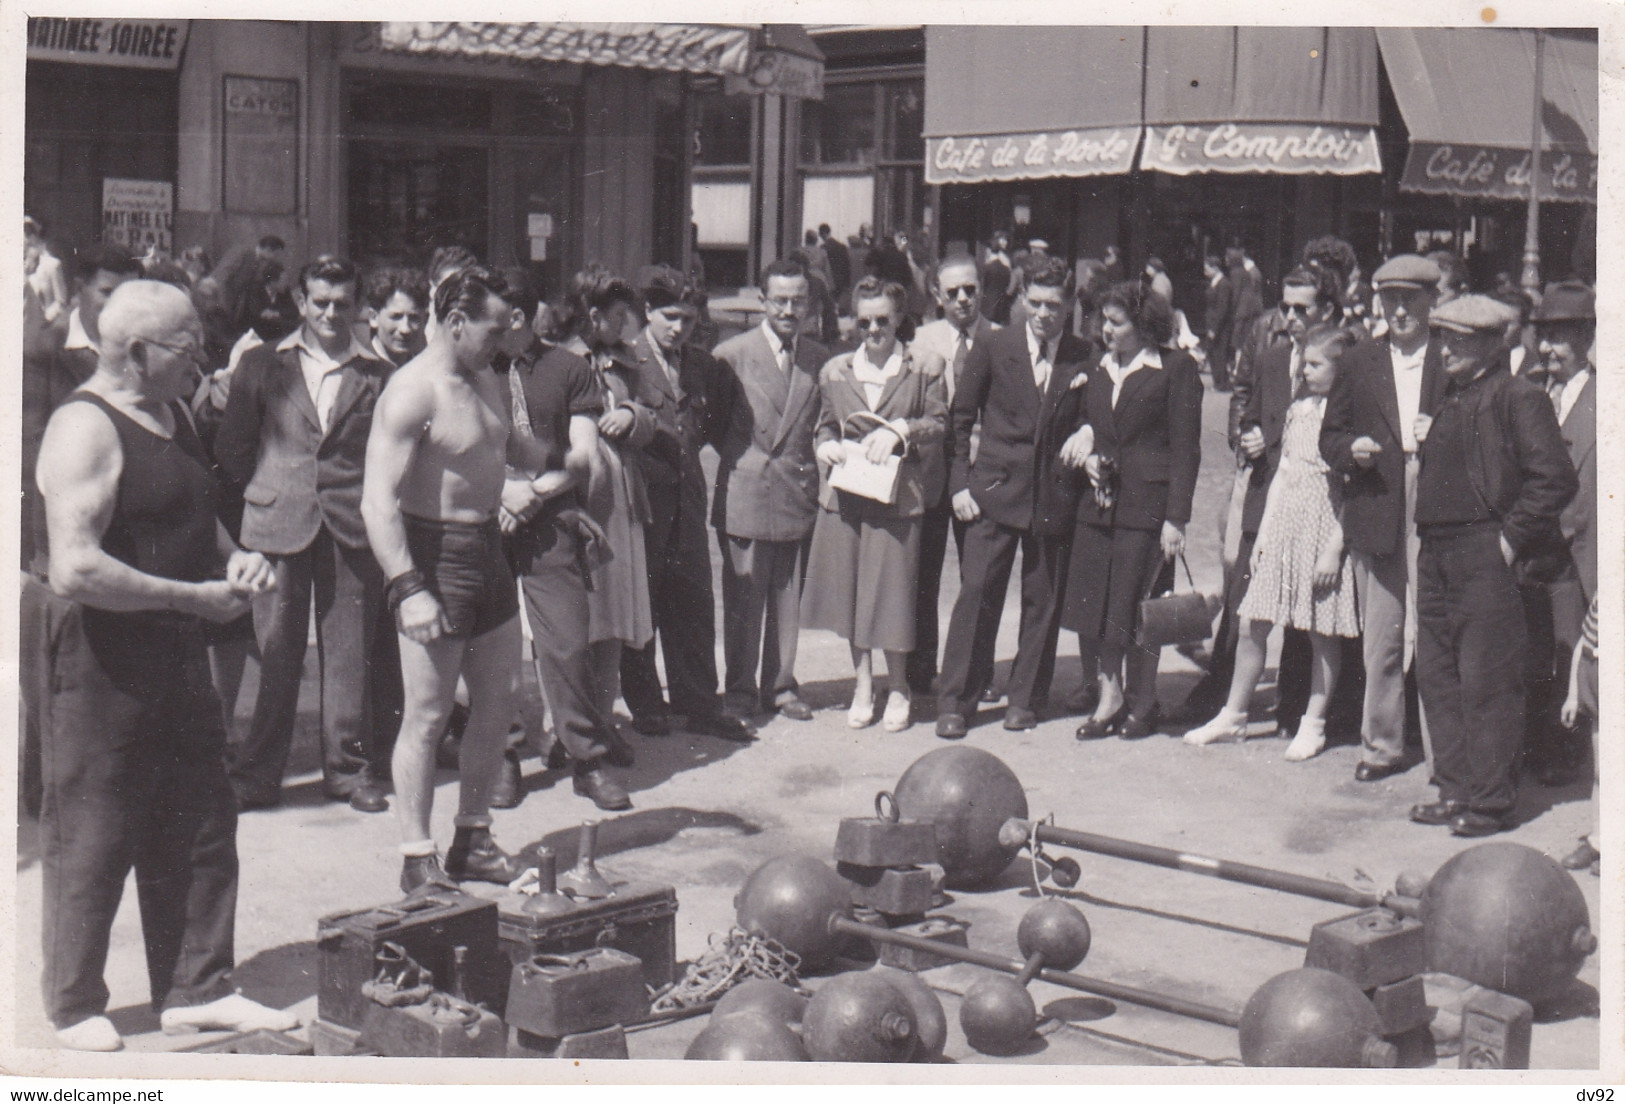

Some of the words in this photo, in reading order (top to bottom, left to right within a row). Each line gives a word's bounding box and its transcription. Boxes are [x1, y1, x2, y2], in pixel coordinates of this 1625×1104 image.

[935, 136, 988, 173] Café
[992, 137, 1019, 167] de
[1024, 133, 1048, 165] la
[1052, 130, 1129, 163] Poste
[1203, 123, 1364, 163] Comptoir
[1426, 146, 1498, 186] Café
[1504, 153, 1534, 185] d
[1552, 154, 1578, 188] la
